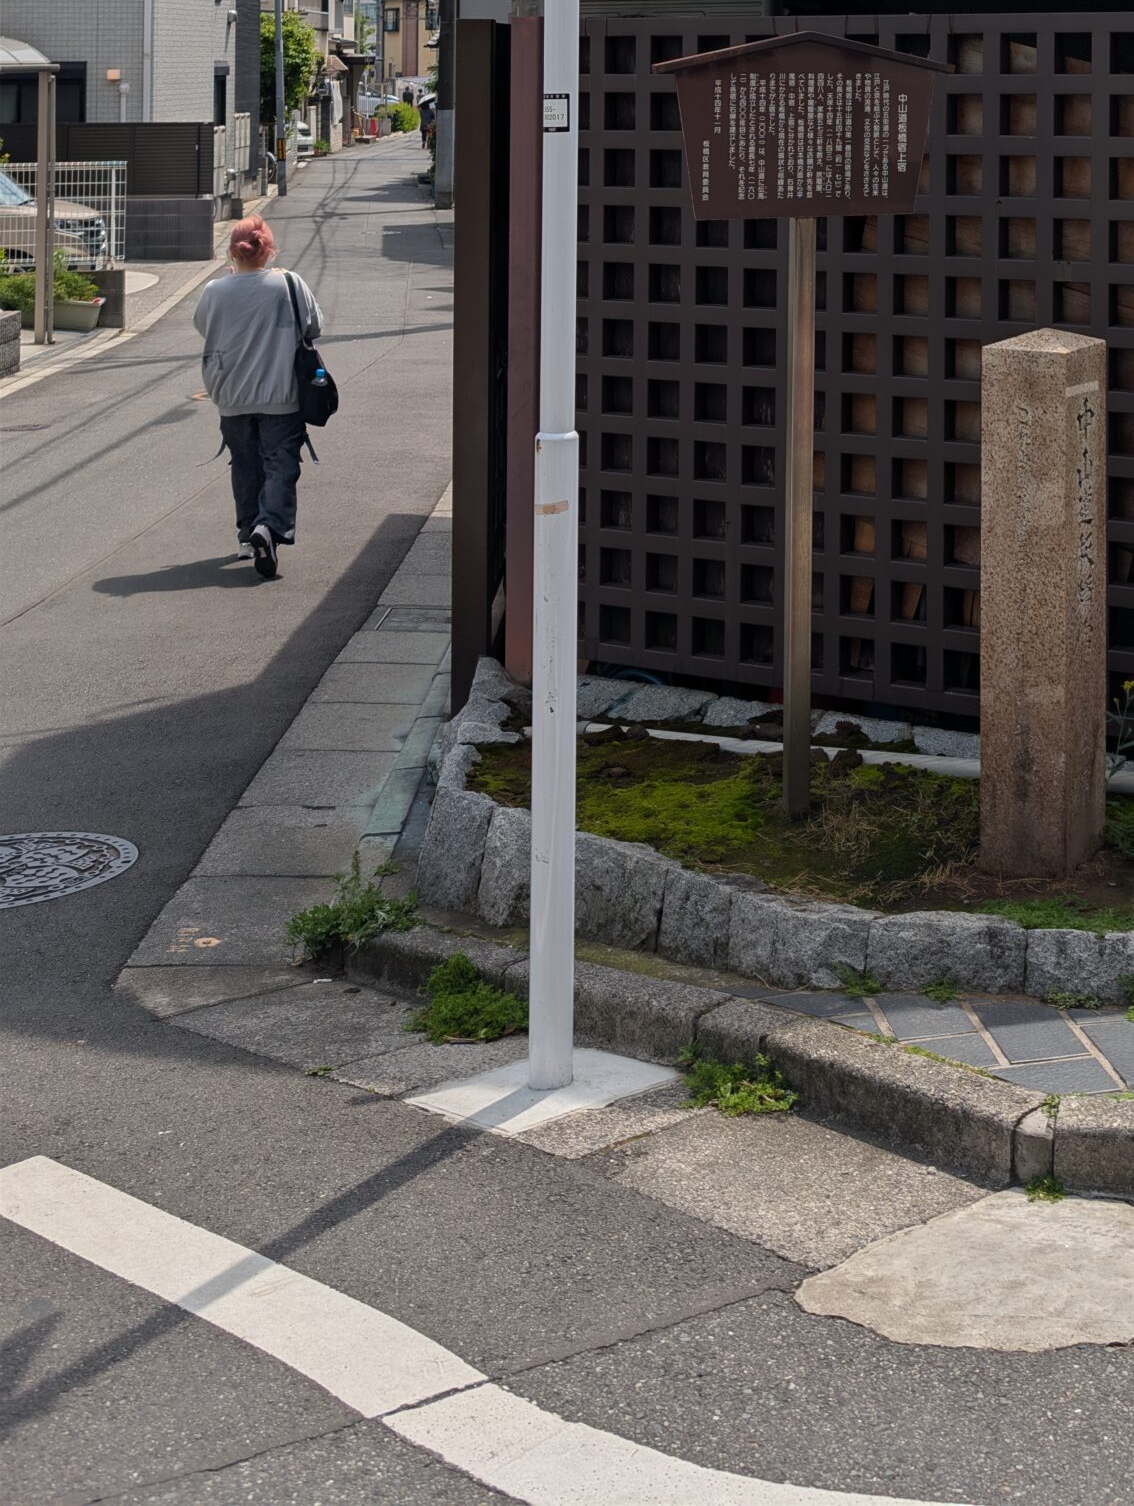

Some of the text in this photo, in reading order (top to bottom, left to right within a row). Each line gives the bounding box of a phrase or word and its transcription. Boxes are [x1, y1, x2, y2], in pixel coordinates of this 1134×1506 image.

[713, 80, 722, 134] 平成十四年十一月
[897, 93, 908, 173] 中山道板橋宿上宿
[702, 141, 710, 202] 板橋区教育委員会
